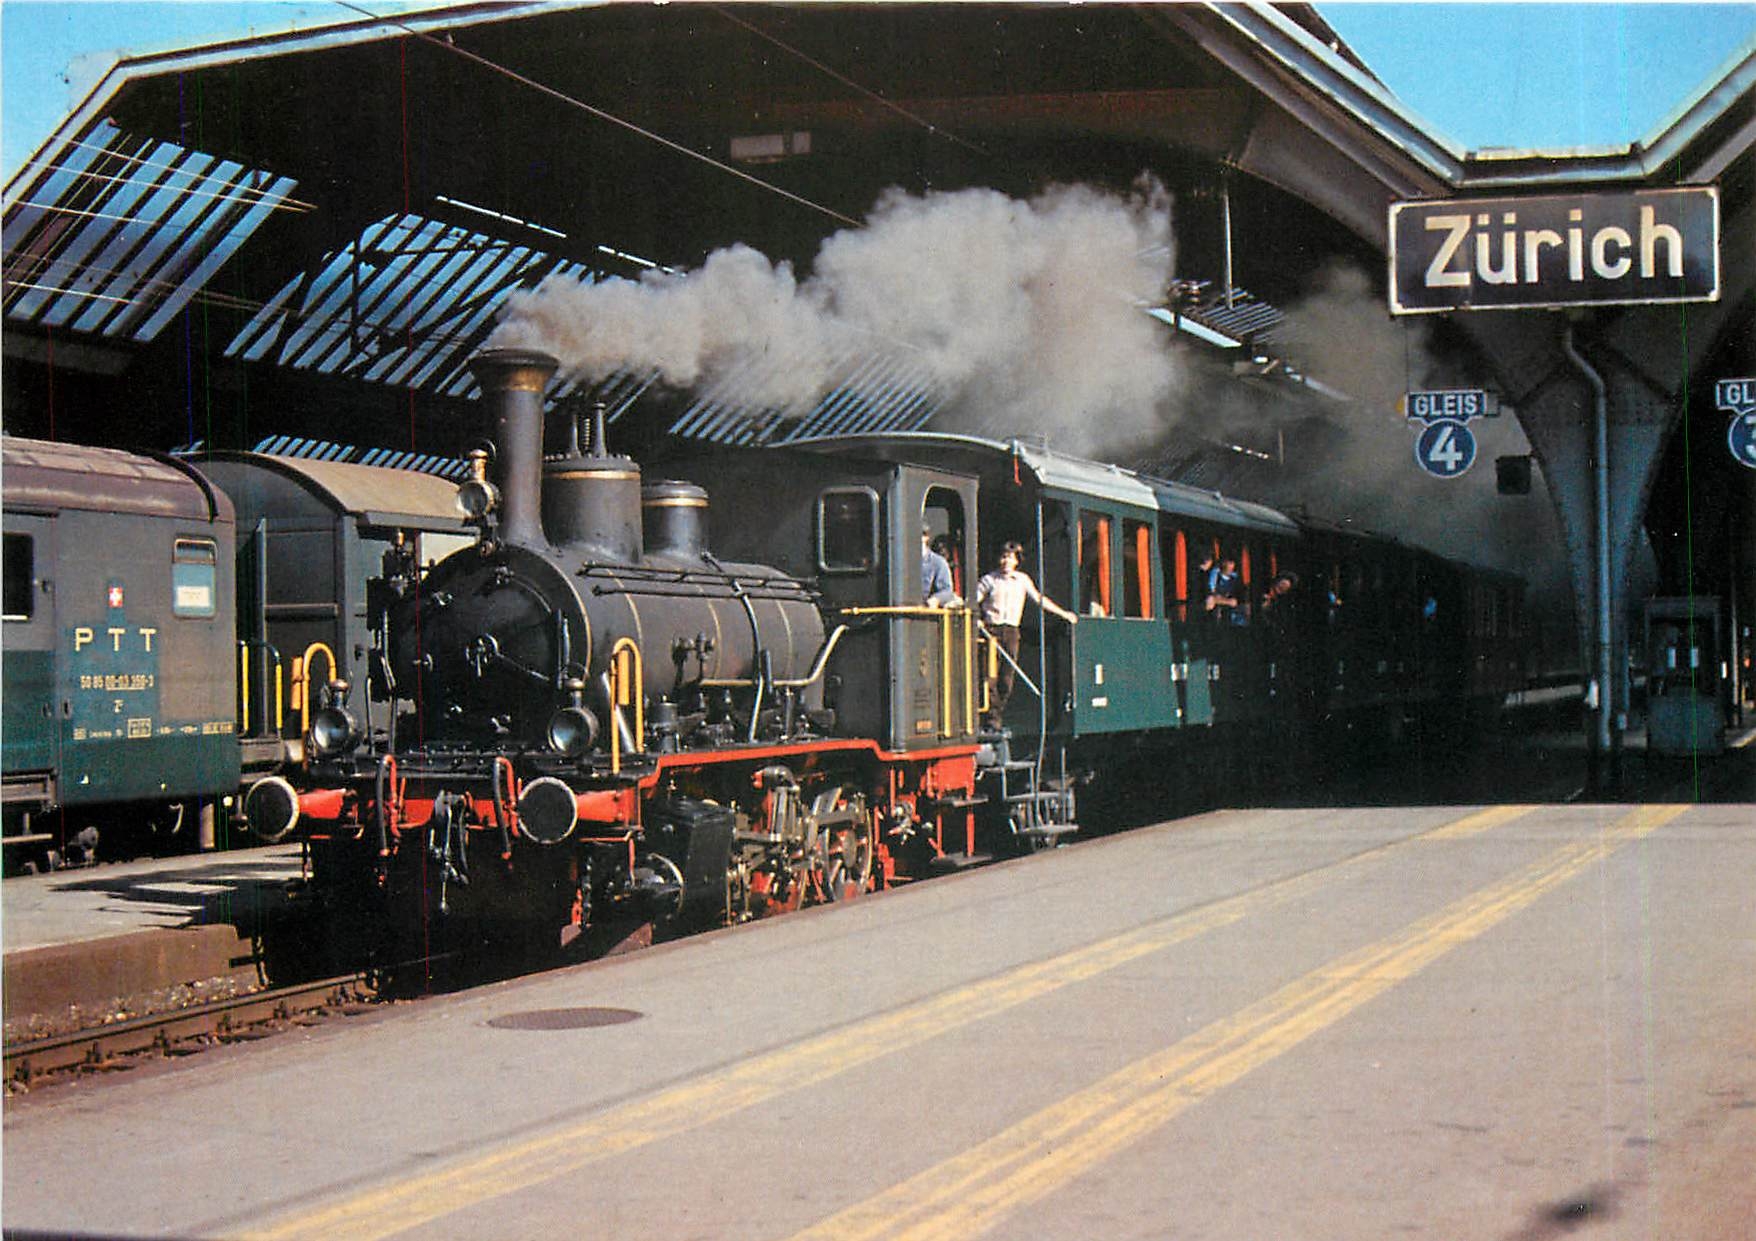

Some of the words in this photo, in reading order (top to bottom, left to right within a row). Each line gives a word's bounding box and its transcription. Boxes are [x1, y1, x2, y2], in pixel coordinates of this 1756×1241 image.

[1424, 204, 1684, 288] Zürich
[1414, 394, 1478, 416] GLEIS
[1429, 425, 1464, 472] 4
